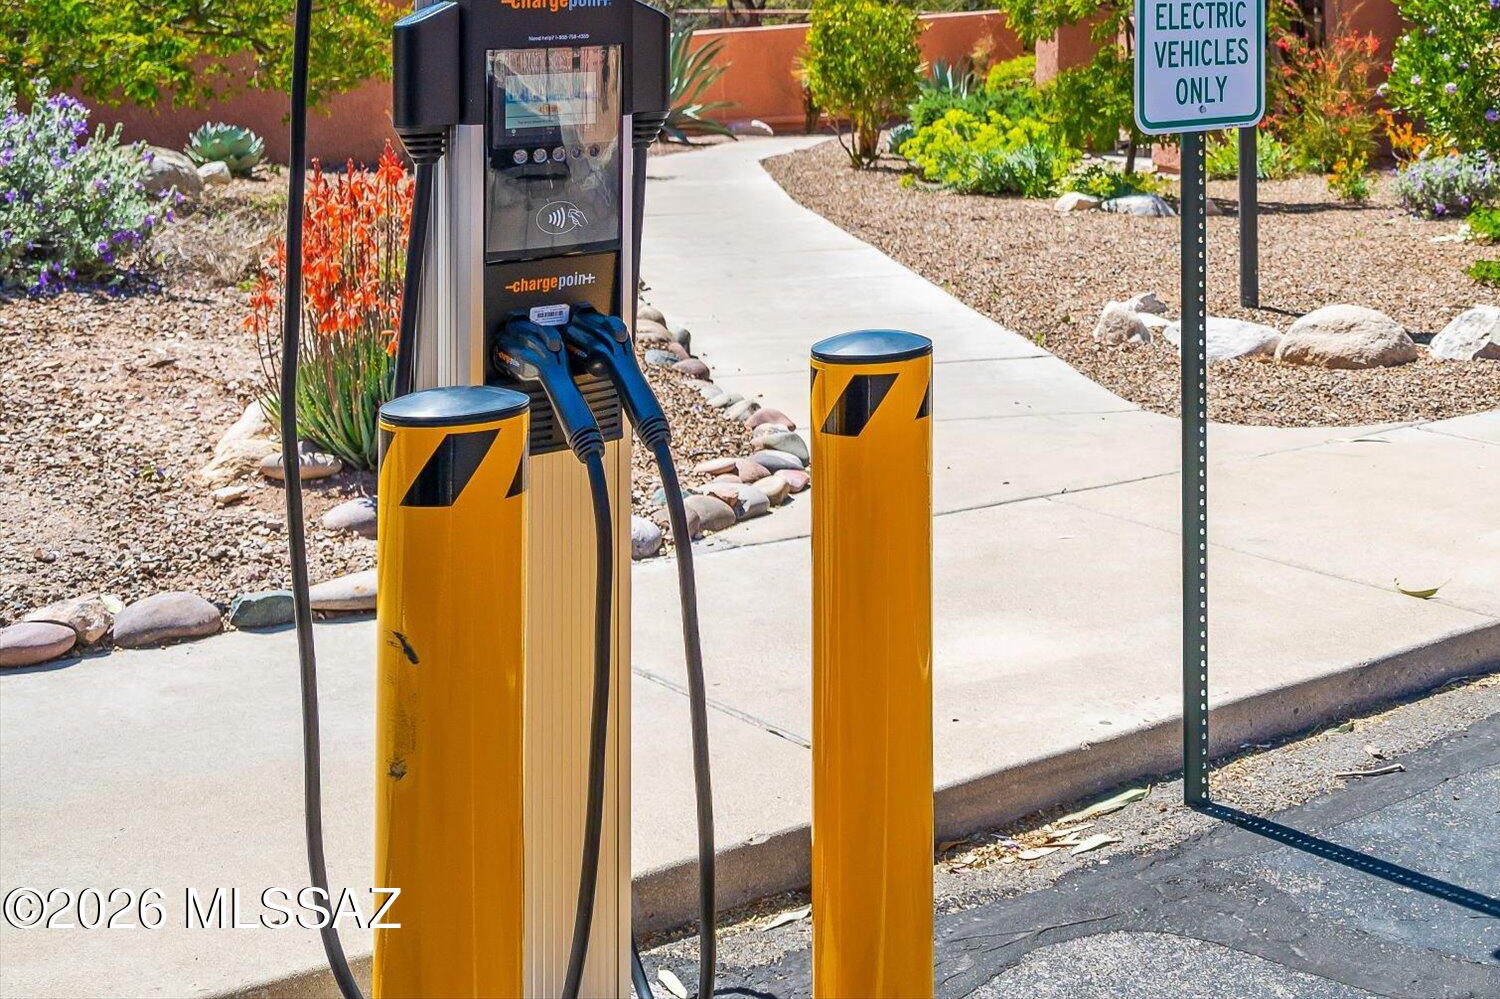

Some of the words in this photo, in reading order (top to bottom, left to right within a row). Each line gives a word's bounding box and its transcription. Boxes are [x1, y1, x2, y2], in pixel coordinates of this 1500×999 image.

[1155, 1, 1247, 31] ELECTRIC
[1154, 38, 1249, 68] VEHICLES
[1175, 75, 1228, 105] ONLY
